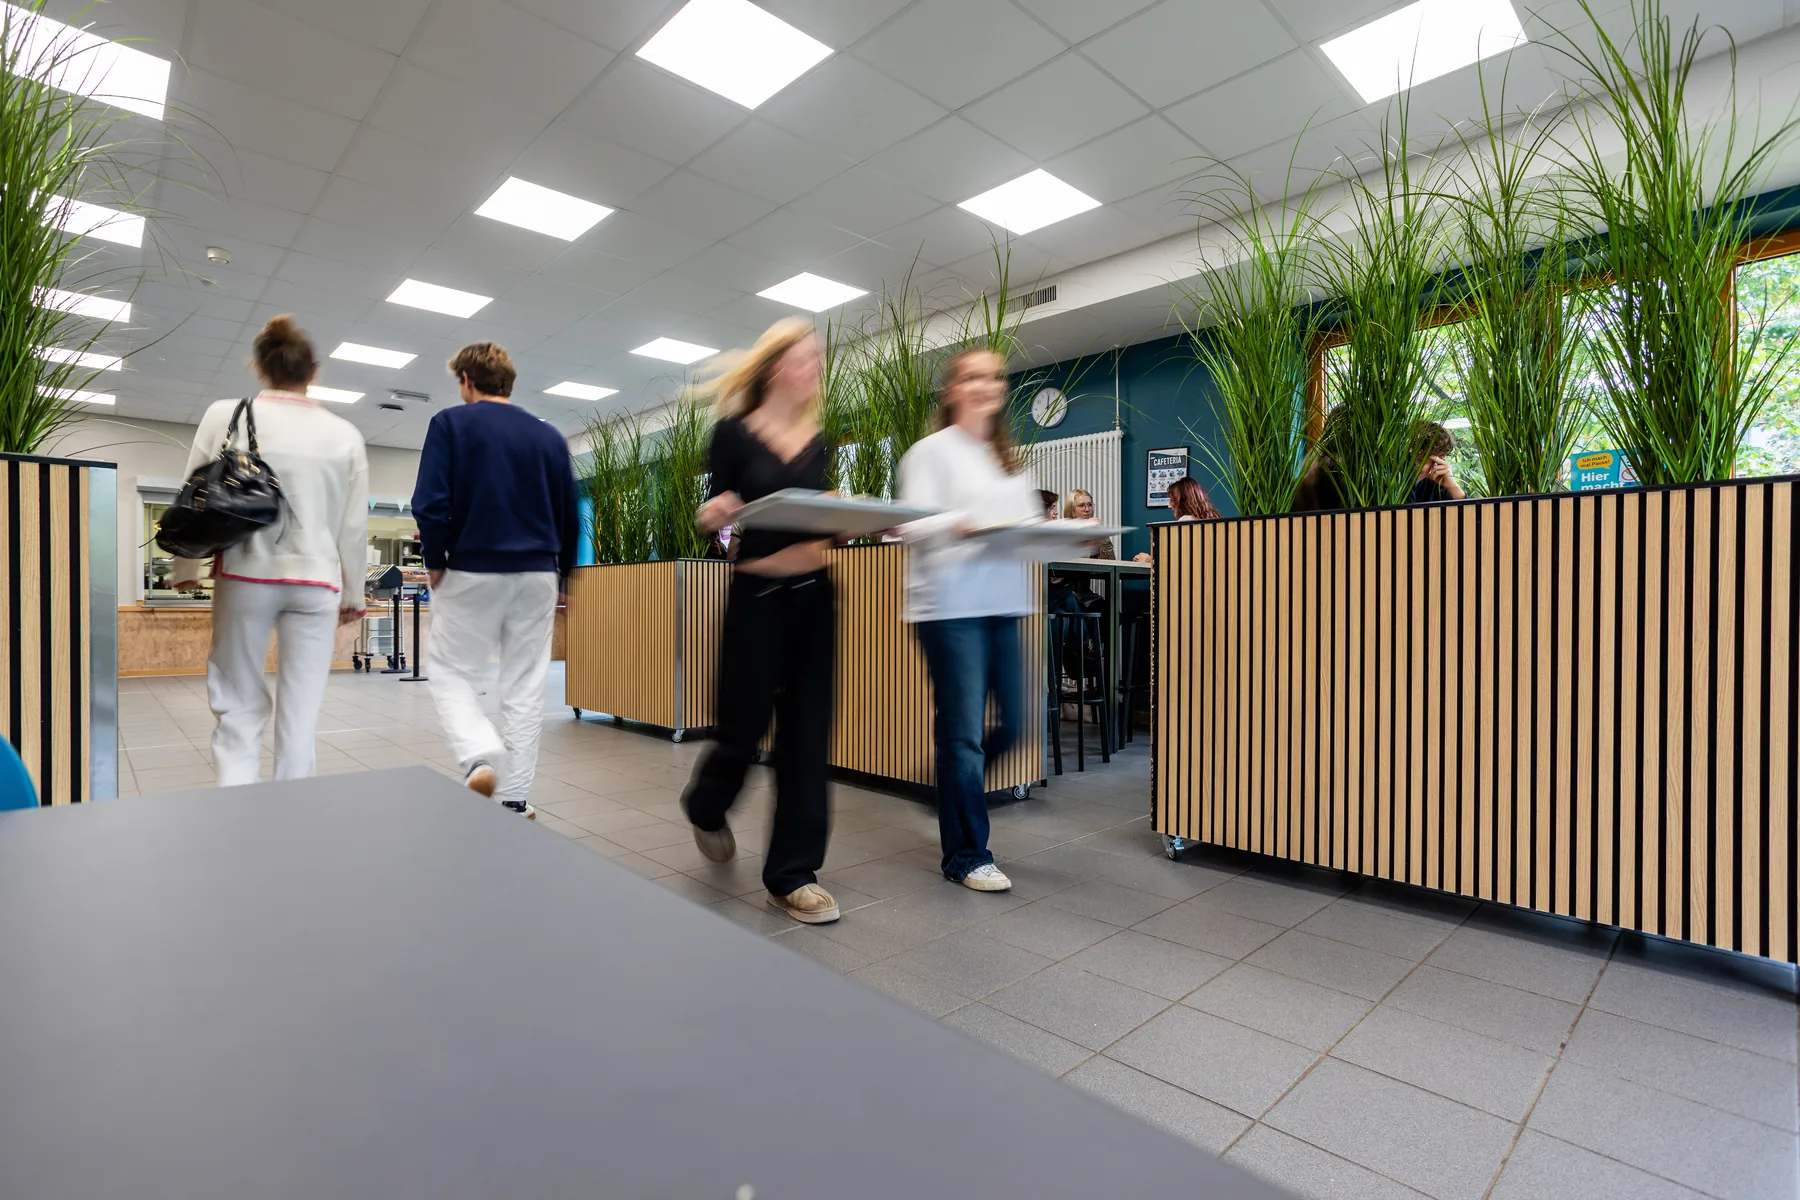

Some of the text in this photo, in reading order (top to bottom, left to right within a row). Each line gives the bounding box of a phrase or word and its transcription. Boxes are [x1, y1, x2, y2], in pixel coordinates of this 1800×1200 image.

[1153, 456, 1182, 467] CAFETERIA
[1581, 472, 1609, 482] Hier
[1581, 482, 1625, 491] macht
